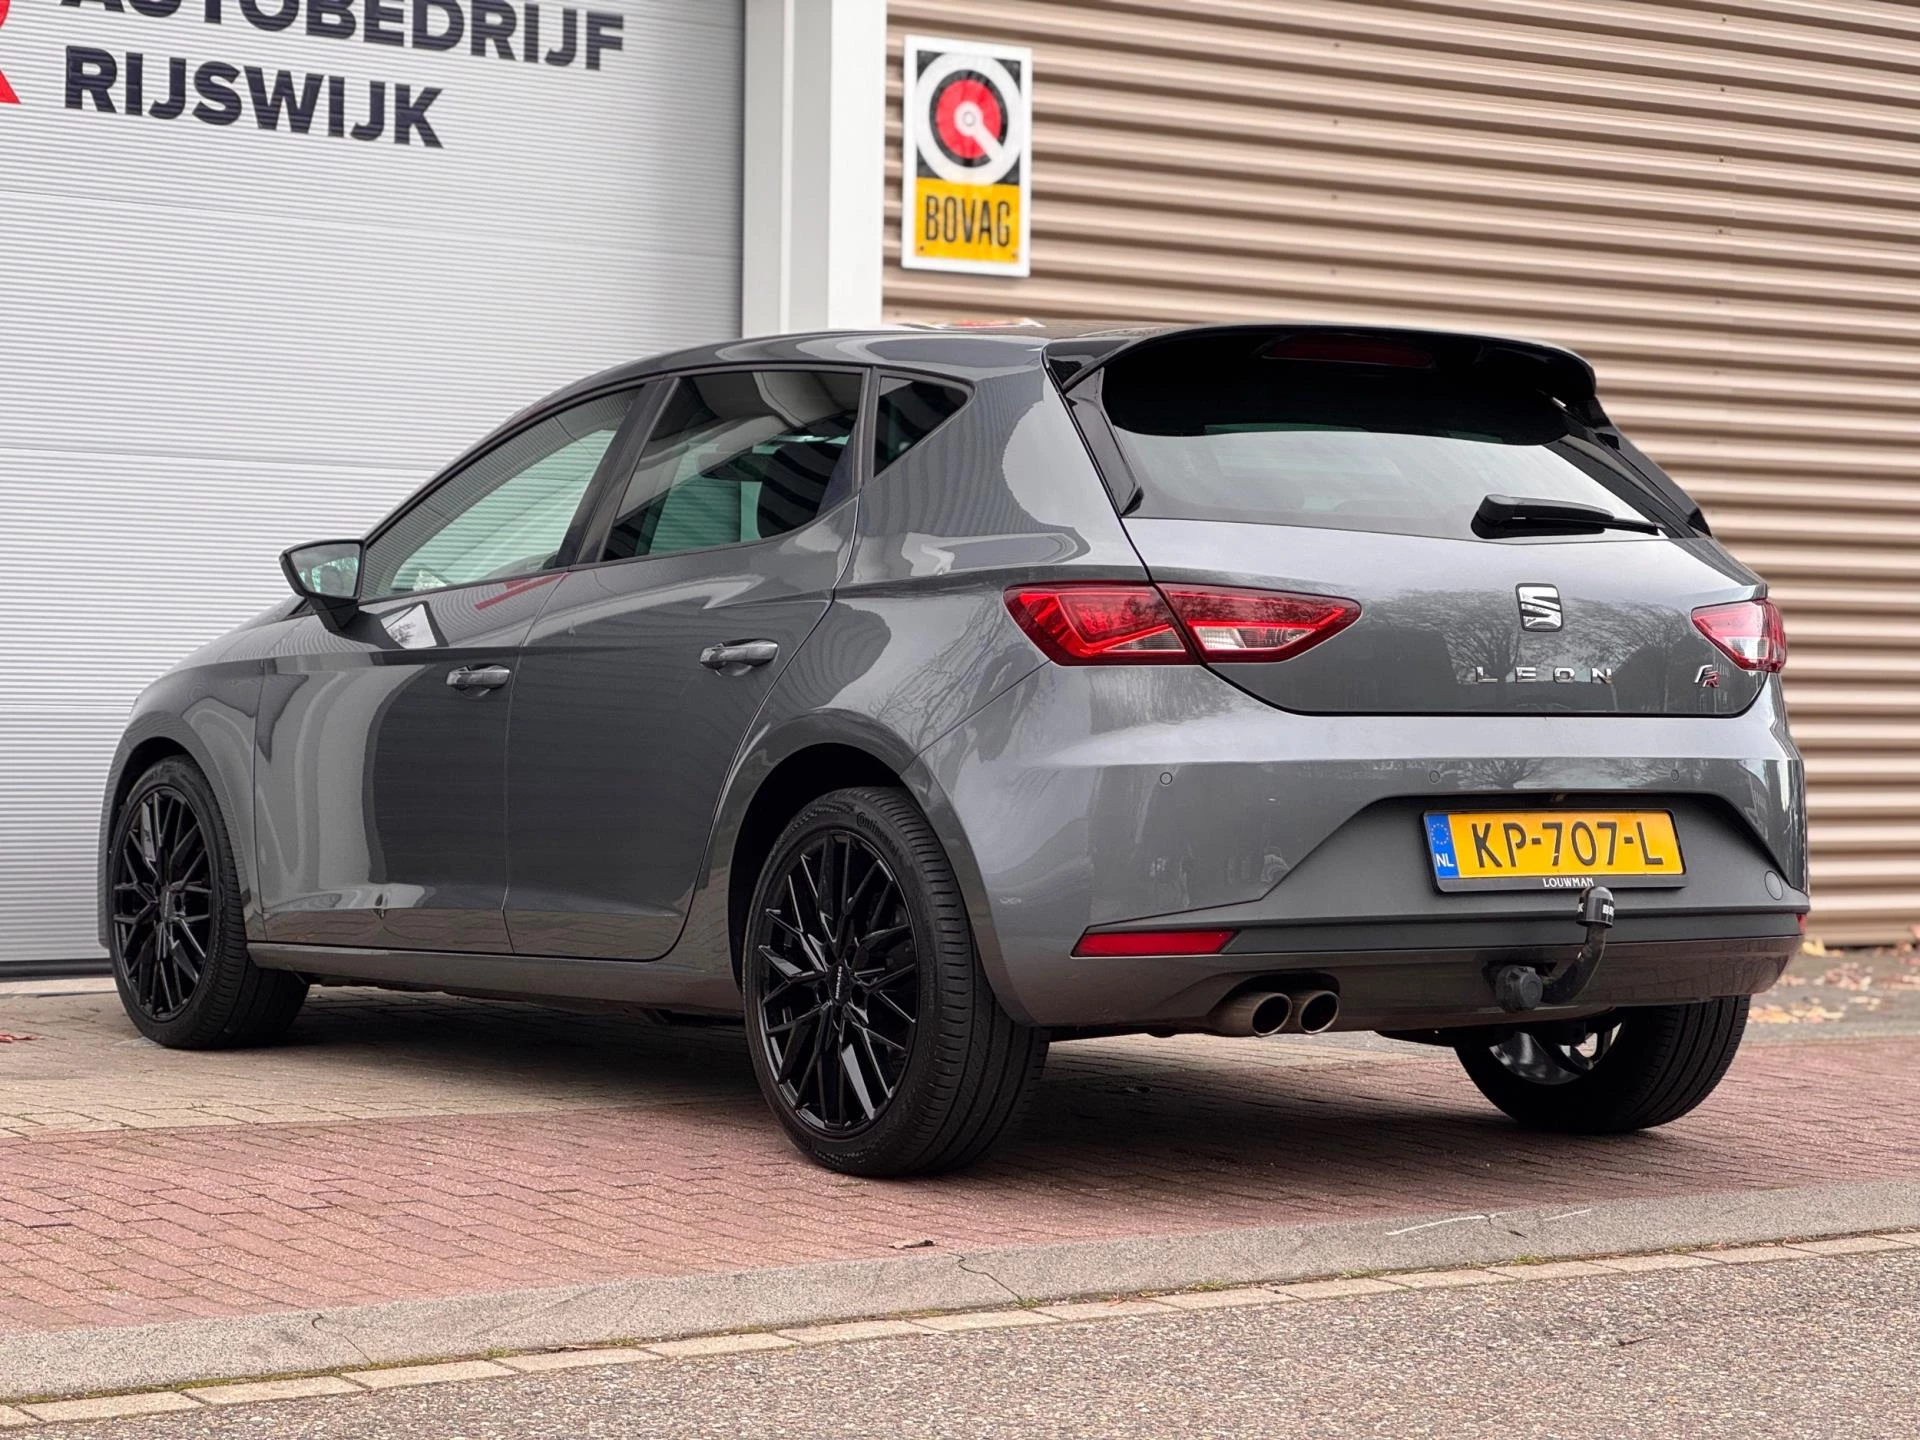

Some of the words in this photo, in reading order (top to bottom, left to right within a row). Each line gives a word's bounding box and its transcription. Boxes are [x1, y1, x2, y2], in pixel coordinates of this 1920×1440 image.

[60, 0, 624, 71] OBEDRIJF
[64, 45, 443, 148] RIJSWIJK
[925, 195, 1010, 247] BOVAG
[1475, 666, 1613, 684] LEON
[1694, 664, 1720, 688] FR
[1435, 853, 1454, 867] NL
[1471, 821, 1664, 868] KP-707-L
[1542, 877, 1594, 888] LOUWMAN
